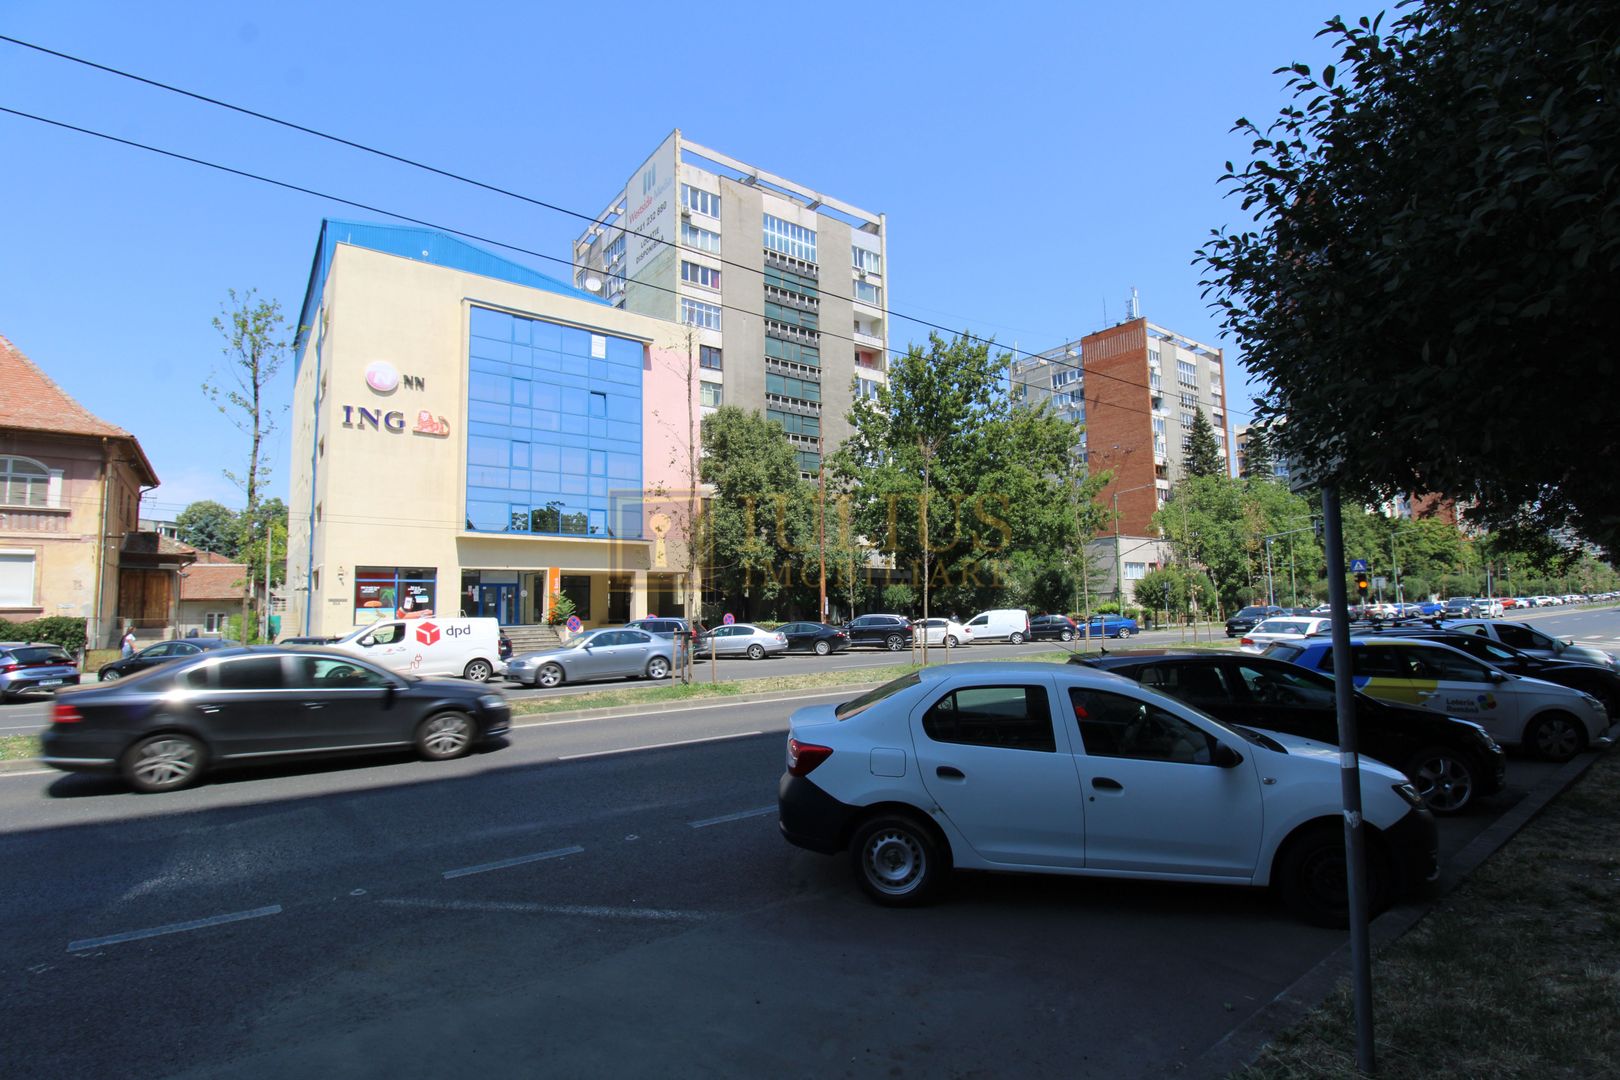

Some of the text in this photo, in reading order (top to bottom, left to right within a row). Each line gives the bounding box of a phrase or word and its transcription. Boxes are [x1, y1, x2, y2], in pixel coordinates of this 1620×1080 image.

[403, 374, 425, 391] NN
[342, 404, 406, 433] ING
[446, 624, 471, 638] dpd
